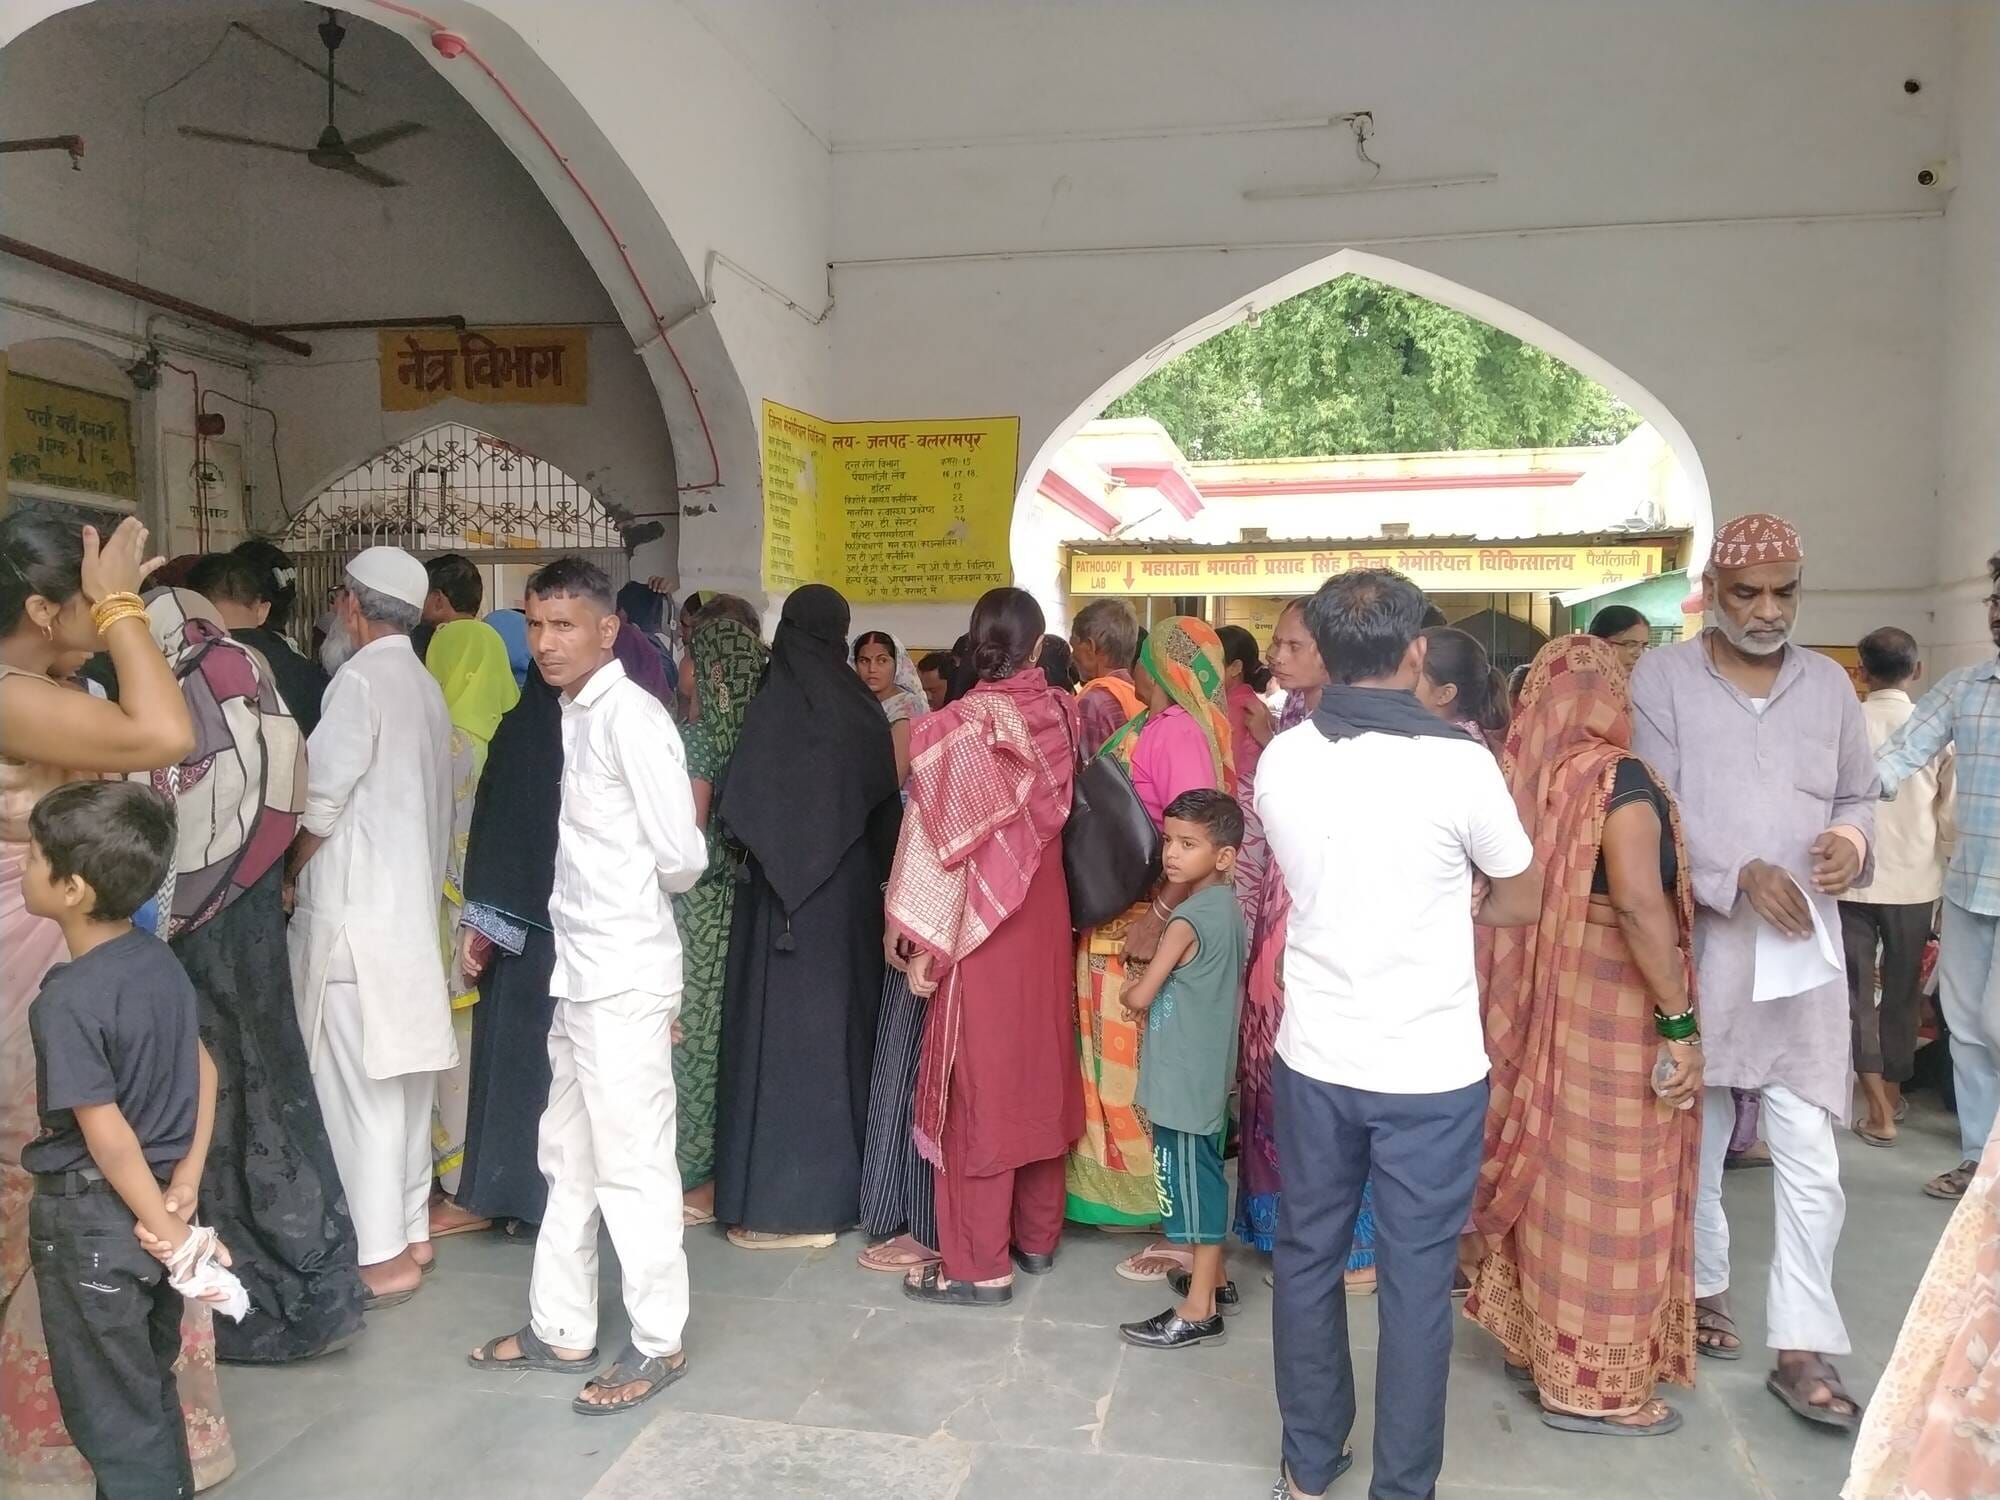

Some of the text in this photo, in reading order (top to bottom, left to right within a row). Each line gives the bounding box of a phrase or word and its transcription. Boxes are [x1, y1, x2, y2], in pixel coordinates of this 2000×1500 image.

[398, 332, 565, 392] नेत्र विभाग
[1076, 560, 1121, 574] PATHOLOGY
[1141, 560, 1200, 577] महाराजा
[1207, 555, 1257, 576] भगवती
[1264, 557, 1306, 576] प्रसाद
[1348, 552, 1391, 571] जिला
[1397, 550, 1471, 572] मेमोरियल
[1478, 549, 1576, 572] चिकित्सालय
[1091, 577, 1106, 589] LAB
